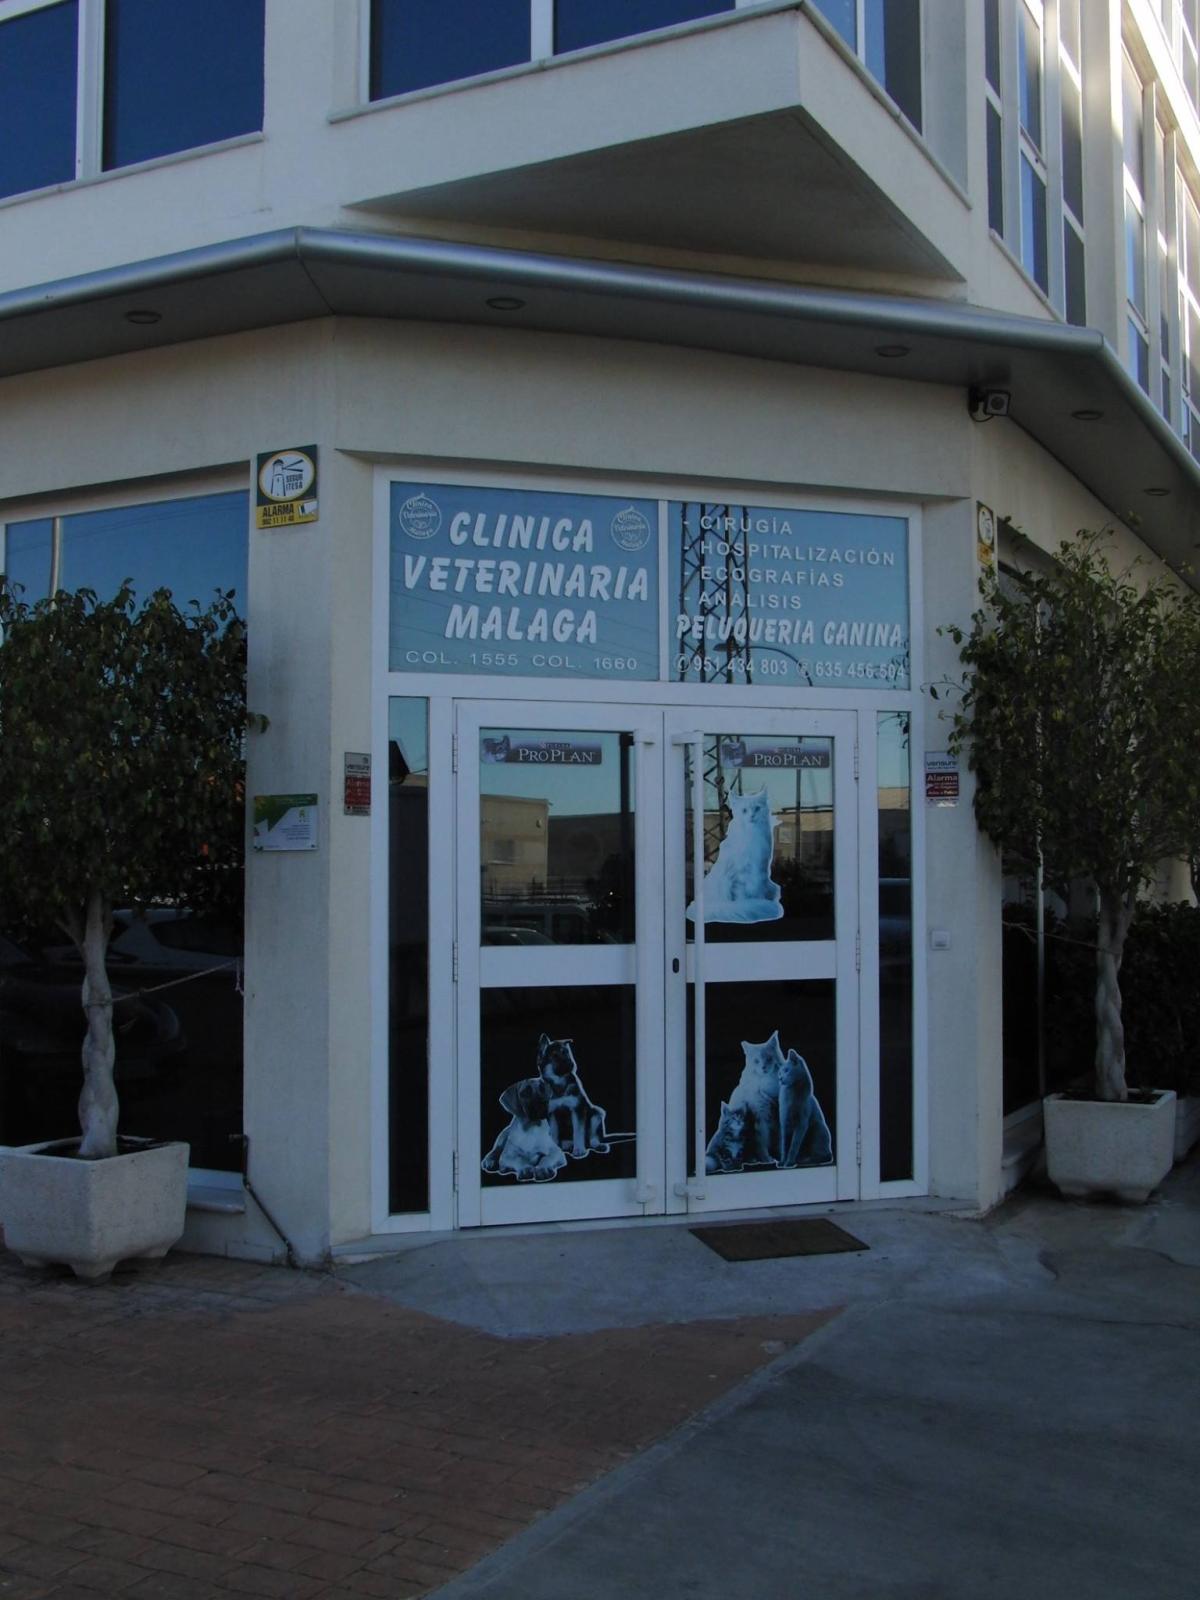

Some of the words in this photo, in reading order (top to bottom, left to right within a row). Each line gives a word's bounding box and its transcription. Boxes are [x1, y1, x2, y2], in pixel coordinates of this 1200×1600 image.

[263, 503, 294, 517] ALARMA
[450, 511, 593, 553] CLINICA
[700, 515, 793, 535] CIRUGÍA
[701, 541, 895, 566] HOSPITALIZACIÓN
[404, 554, 648, 601] VETERINARIA
[701, 566, 844, 587] ECOGRAFÍAS
[445, 604, 597, 644] MALAGA
[676, 614, 814, 645] PELUQUERIA
[824, 621, 901, 648] CANINA
[406, 651, 458, 665] COL.
[470, 653, 518, 666] 1555
[532, 655, 582, 668] COL.
[594, 657, 638, 671] 1660
[694, 657, 721, 672] 951
[727, 658, 755, 673] 434
[761, 660, 788, 674] 803
[816, 661, 842, 677] 635
[847, 662, 874, 678] 456
[880, 663, 905, 678] 504
